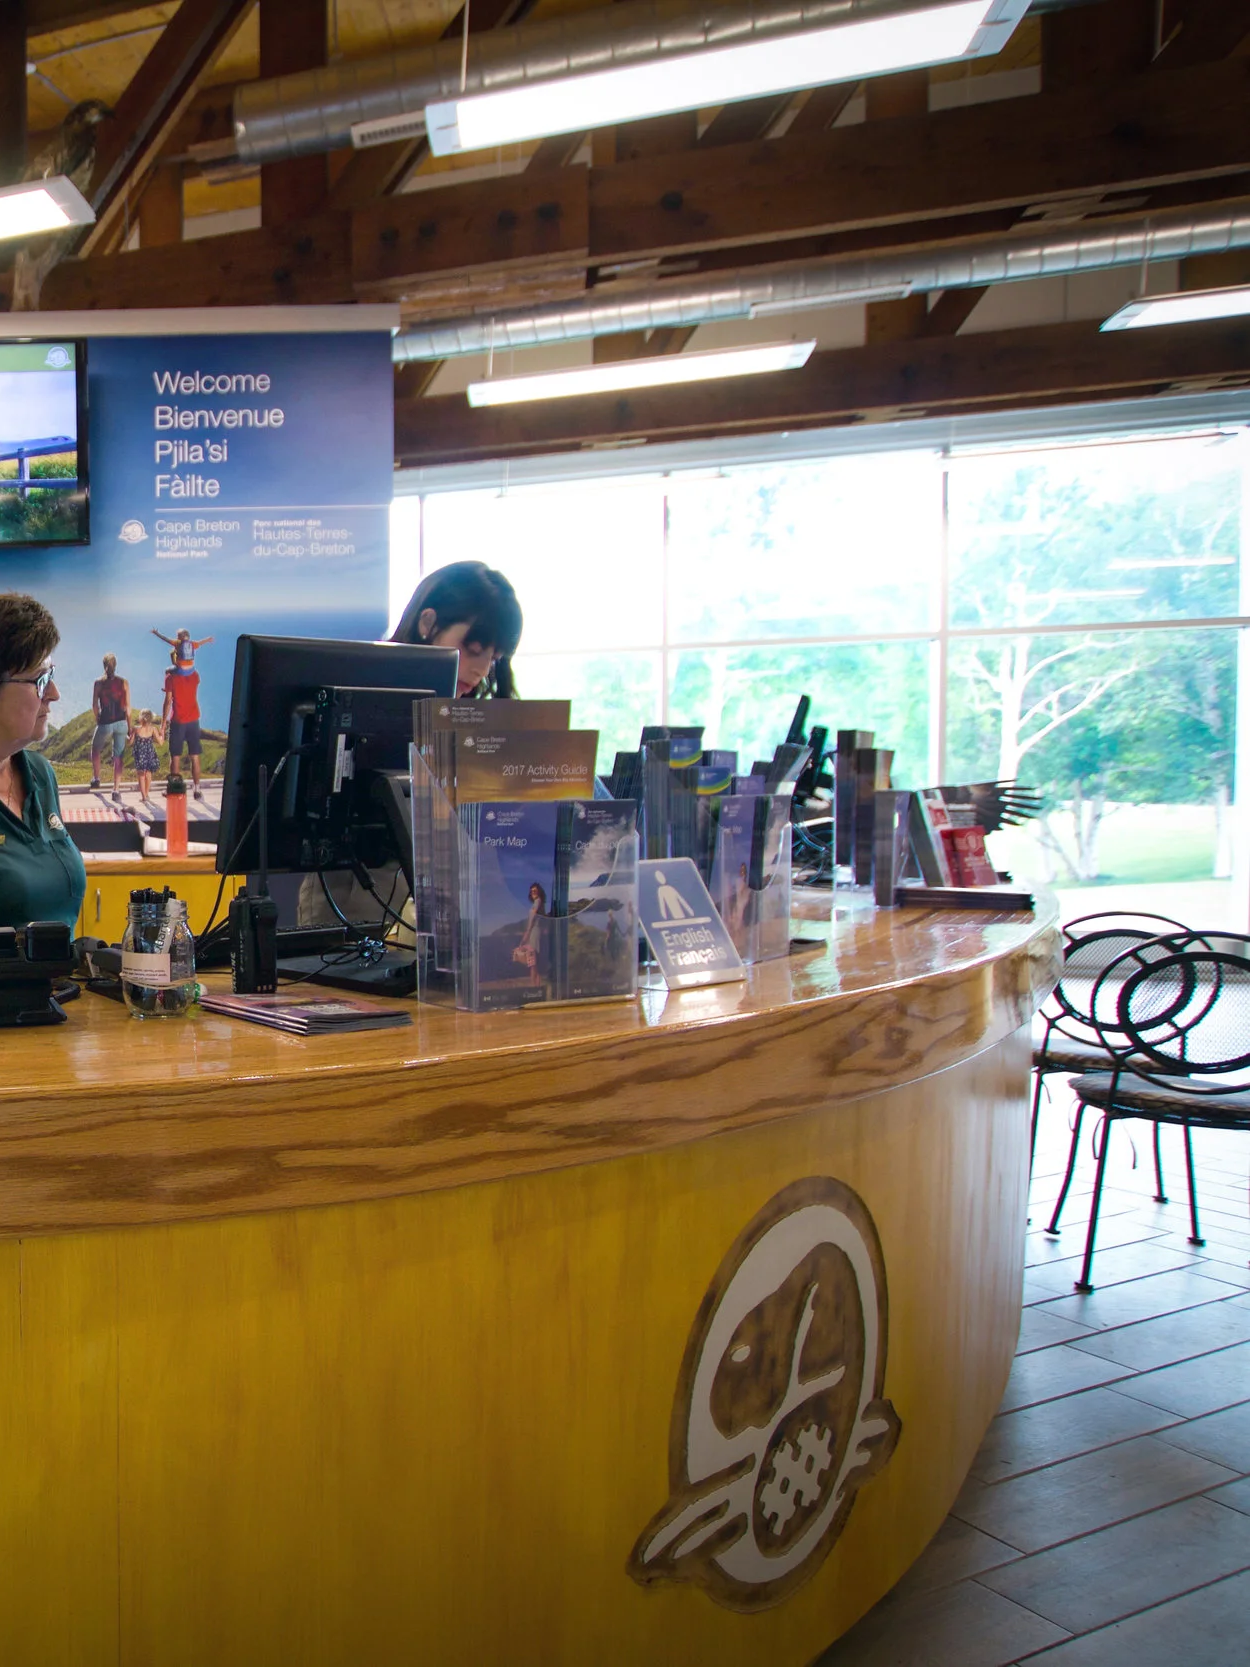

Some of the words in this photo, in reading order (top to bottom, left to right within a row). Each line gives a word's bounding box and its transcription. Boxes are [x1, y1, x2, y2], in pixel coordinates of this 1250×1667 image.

[152, 370, 271, 395] Welcome
[154, 405, 285, 430] Bienvenue
[155, 474, 221, 498] Fàilte
[155, 520, 192, 534] Cape
[195, 518, 241, 532] Breton
[273, 519, 305, 527] national
[155, 535, 223, 550] Highlands
[253, 542, 356, 557] du-Cap-Breton
[190, 550, 209, 558] Park
[502, 764, 526, 776] 2017
[527, 764, 559, 777] Activity
[561, 764, 588, 776] Guide
[484, 836, 505, 847] Park
[506, 836, 528, 848] Map
[661, 926, 715, 948] English
[666, 943, 728, 966] Français
